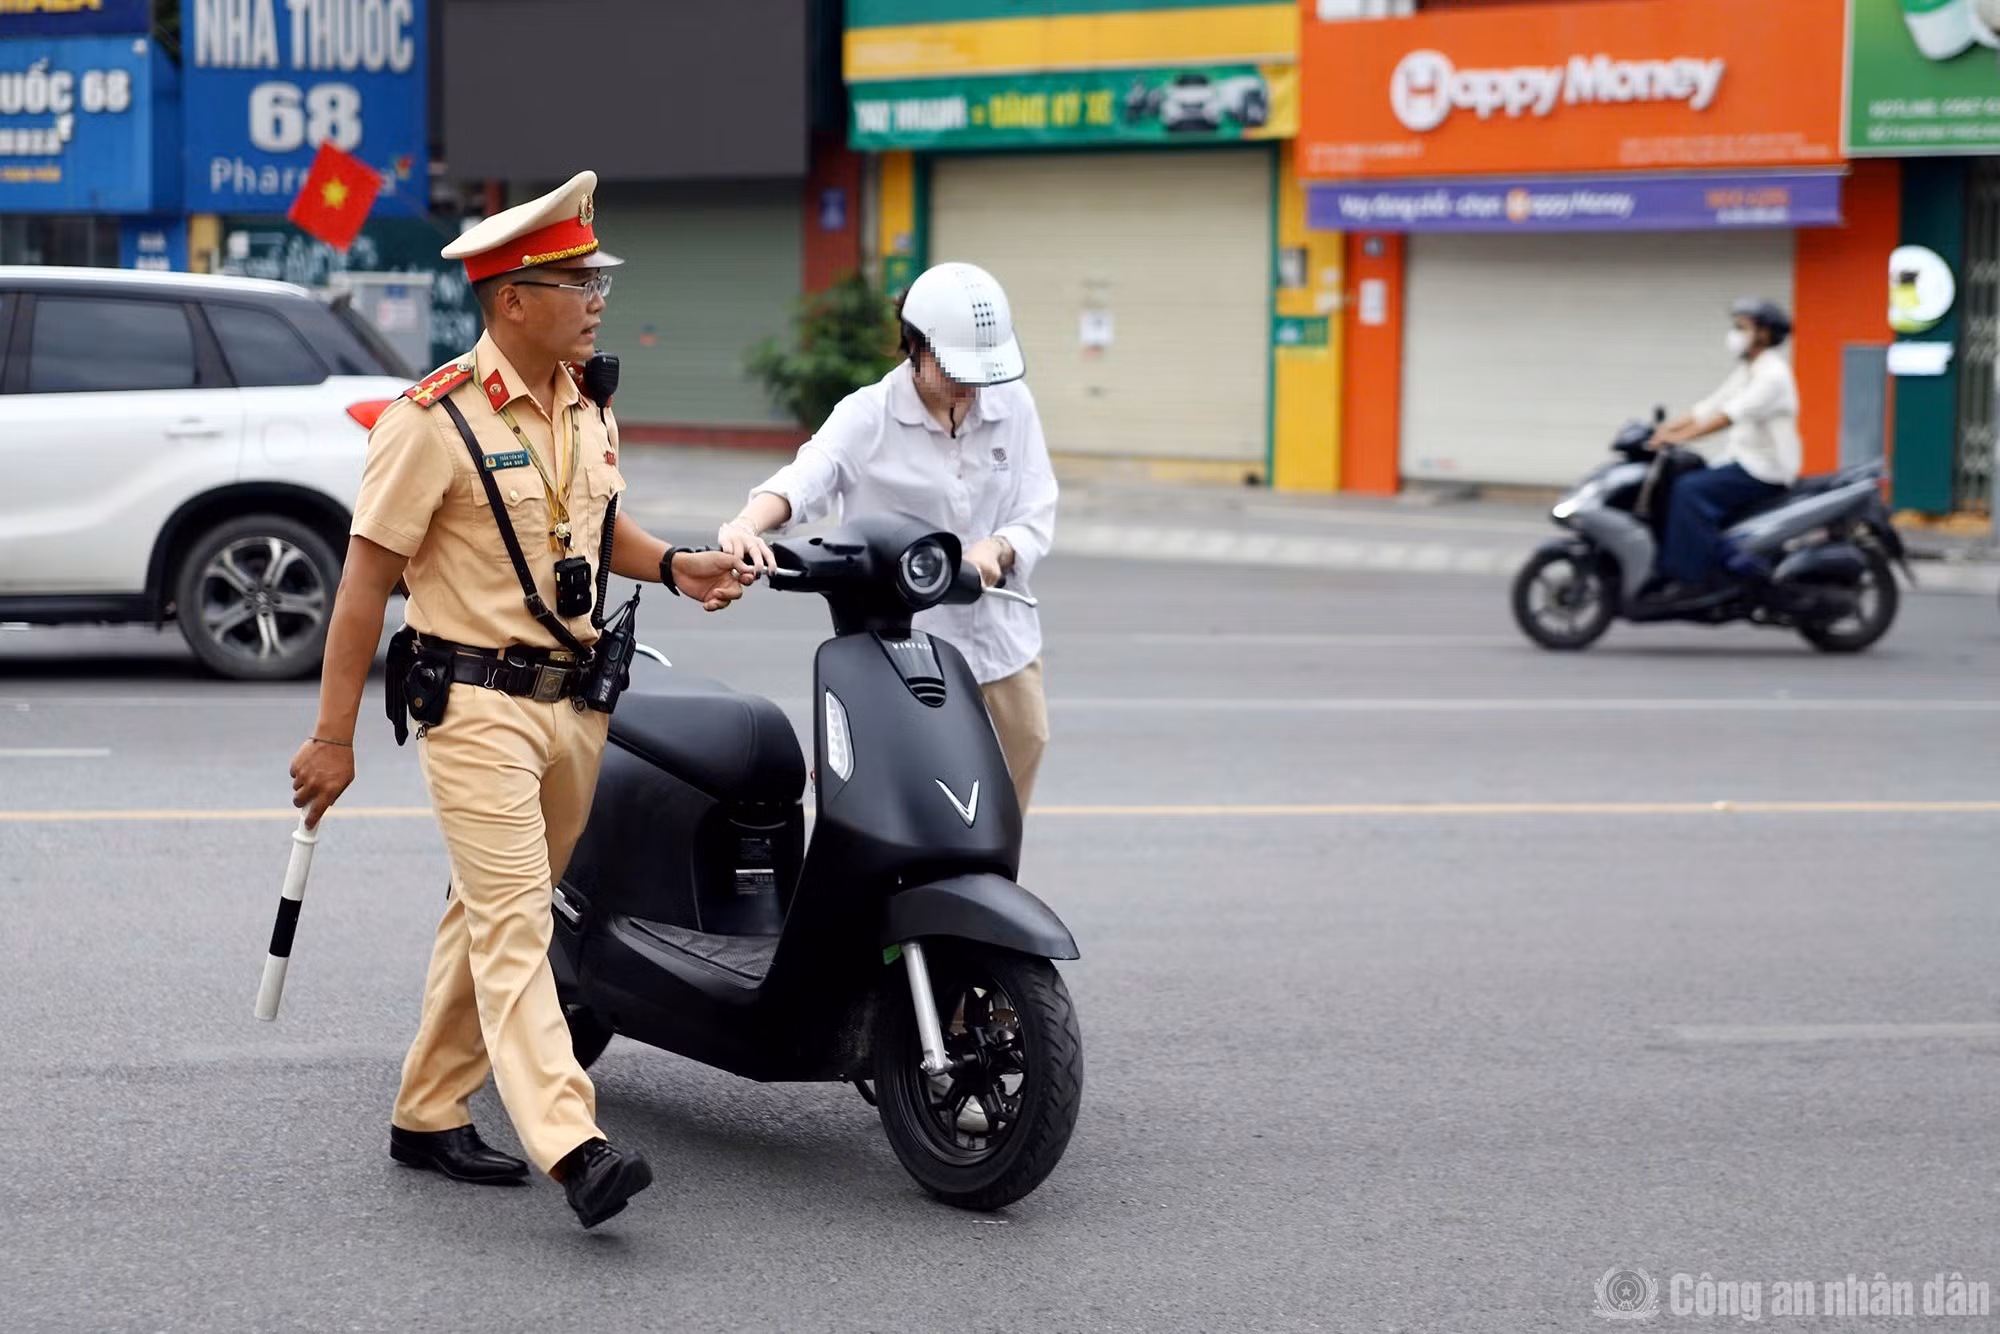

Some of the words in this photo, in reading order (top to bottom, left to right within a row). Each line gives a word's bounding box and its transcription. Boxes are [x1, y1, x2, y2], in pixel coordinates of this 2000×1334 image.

[81, 69, 131, 113] 68
[1563, 53, 1725, 111] Money
[250, 81, 362, 153] 68
